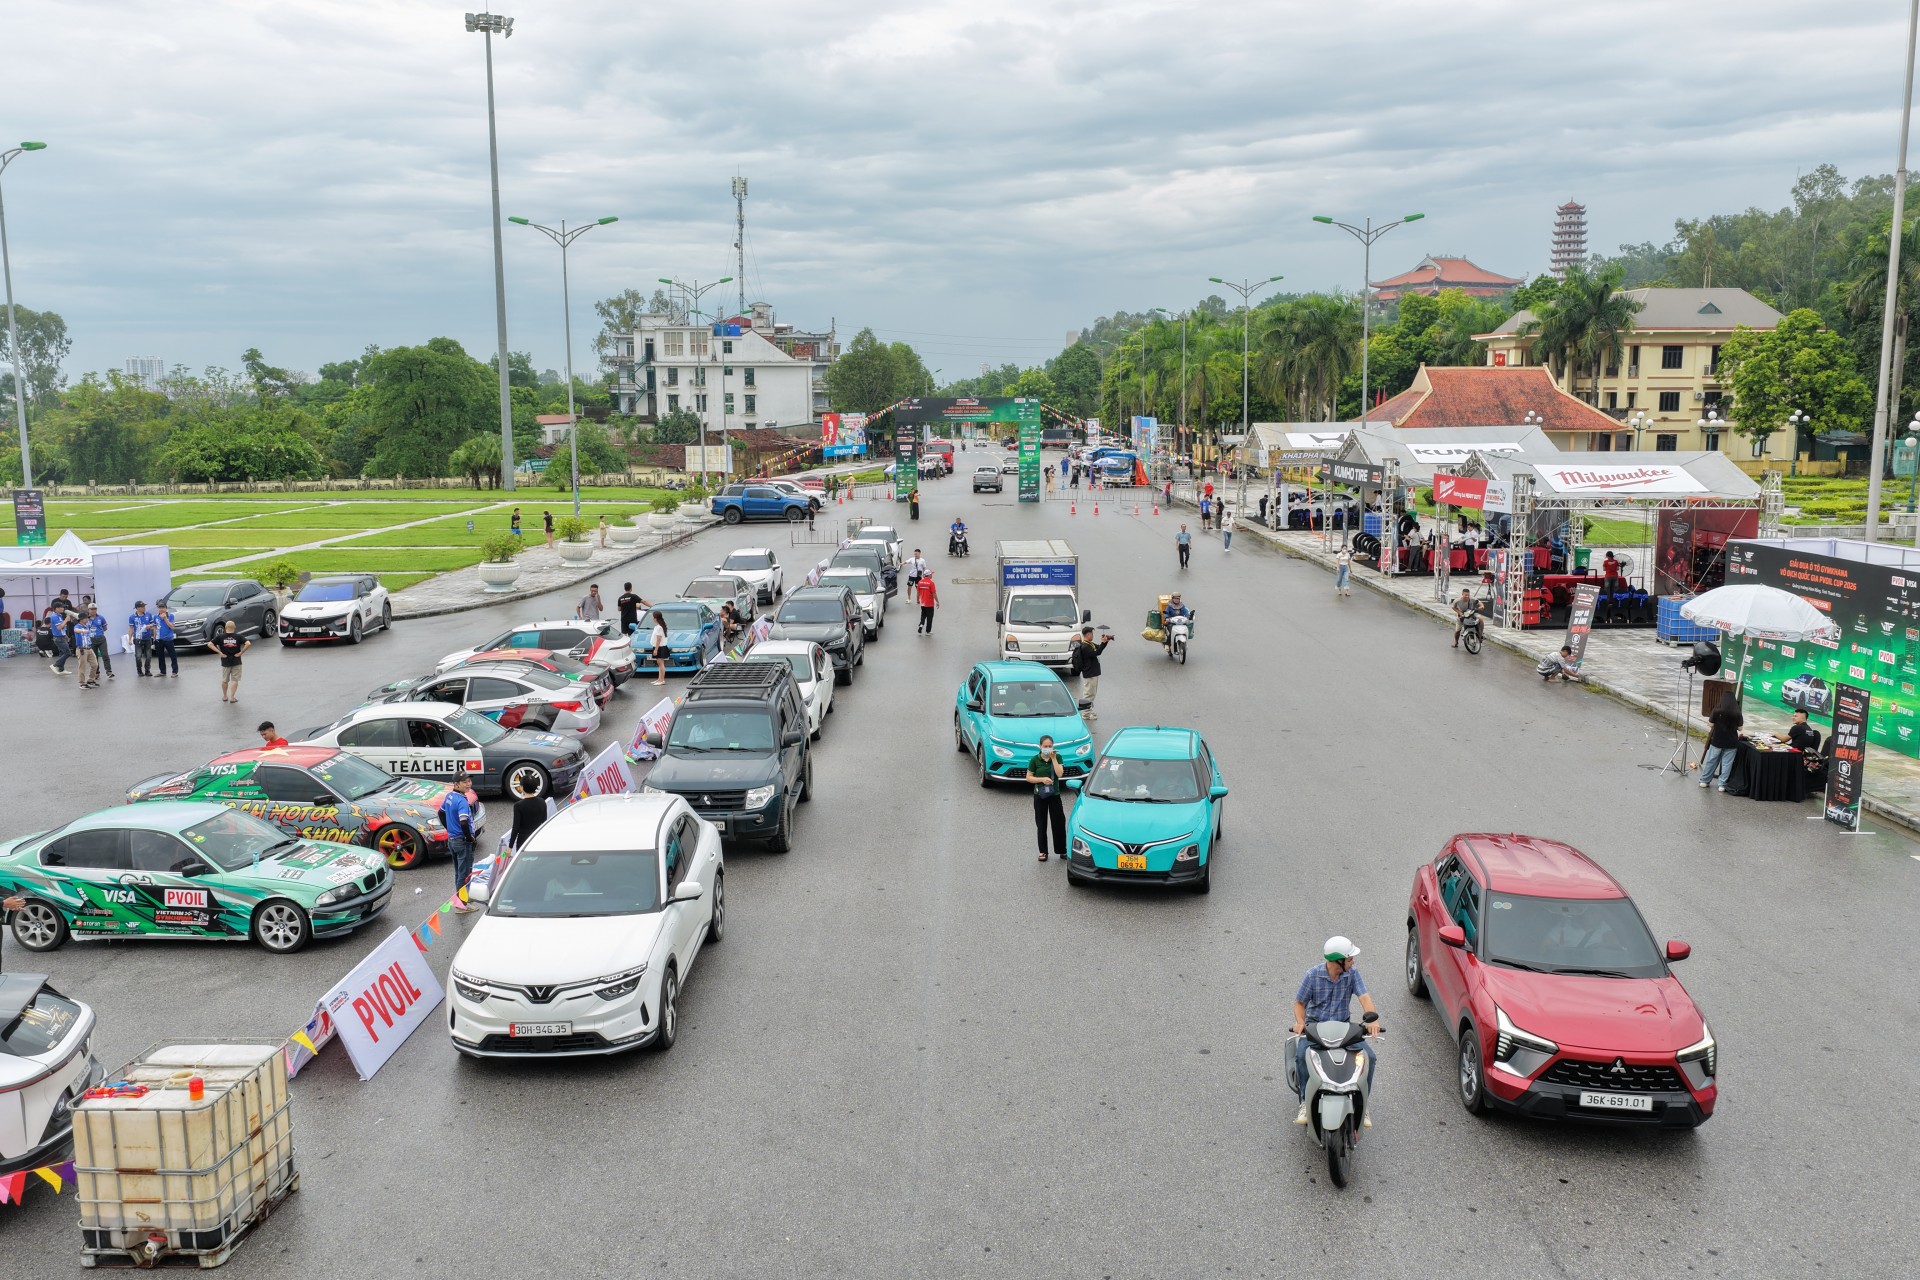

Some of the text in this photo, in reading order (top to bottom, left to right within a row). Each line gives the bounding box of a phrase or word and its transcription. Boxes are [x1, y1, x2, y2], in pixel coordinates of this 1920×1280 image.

[1334, 465, 1368, 482] KUMHO TIRE
[1552, 468, 1673, 485] Milwaukee
[1834, 579, 1843, 587] CUP
[1906, 580, 1917, 588] VISA
[1715, 620, 1732, 630] PVOIL
[1783, 646, 1794, 657] PVOIL
[1880, 651, 1894, 663] PVOIL
[1850, 667, 1864, 678] PVOIL
[1837, 735, 1844, 744] IN
[210, 764, 237, 775] VISA
[389, 760, 466, 772] TEACHER
[597, 761, 626, 794] PVOIL
[268, 802, 340, 826] MOTOR
[302, 825, 359, 844] SHOW
[101, 890, 136, 903] VISA
[167, 891, 204, 906] PVOIL
[352, 961, 422, 1044] PVOIL
[515, 1025, 566, 1034] 30H-946.35
[1586, 1095, 1645, 1107] 36K-691.01
